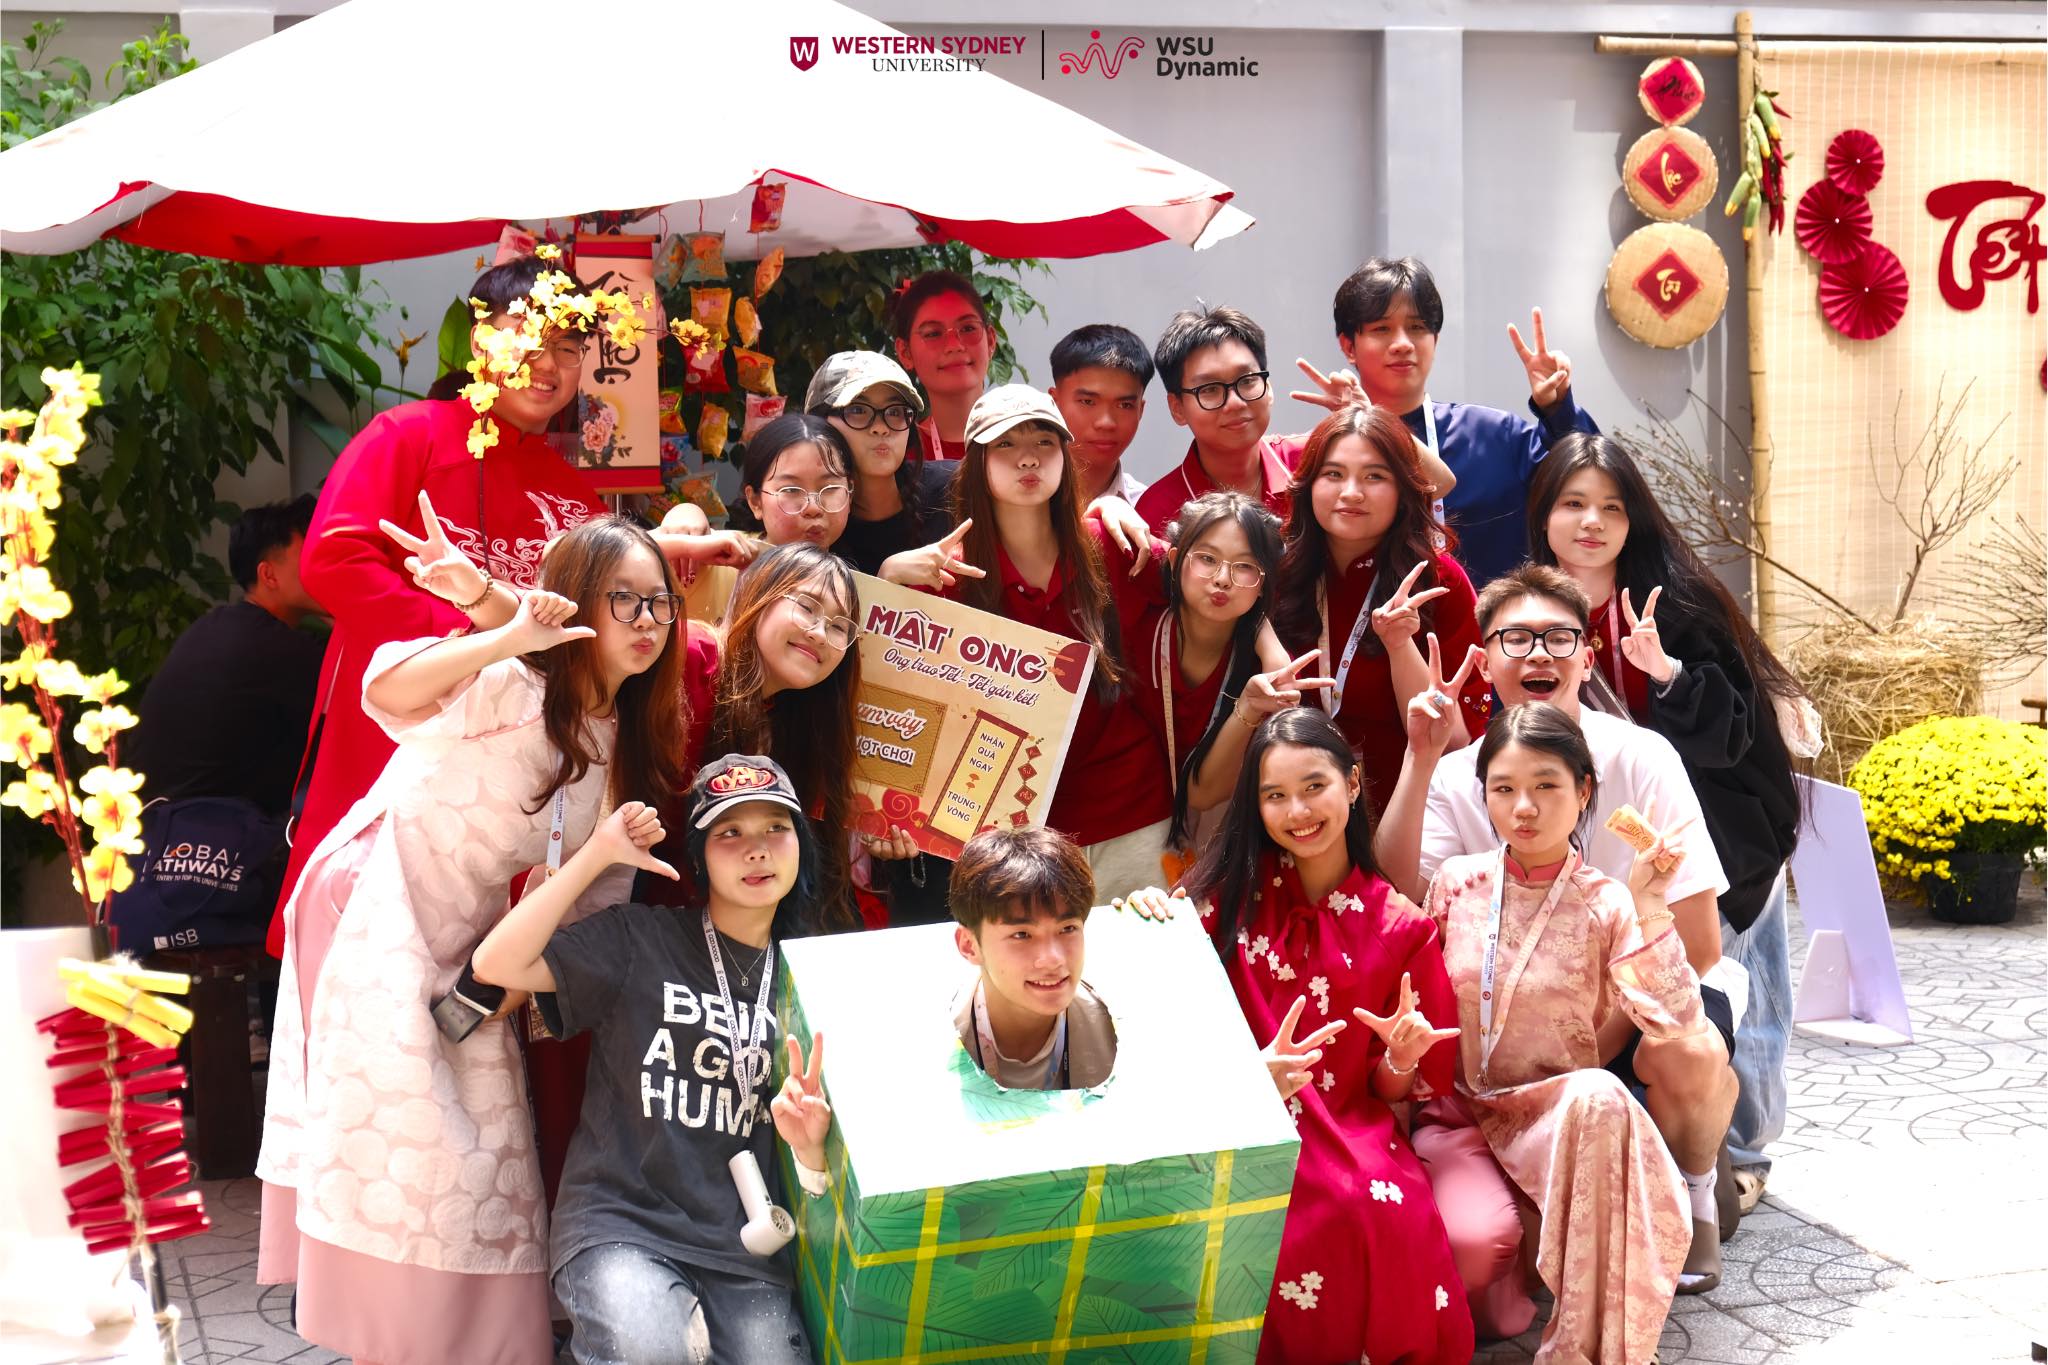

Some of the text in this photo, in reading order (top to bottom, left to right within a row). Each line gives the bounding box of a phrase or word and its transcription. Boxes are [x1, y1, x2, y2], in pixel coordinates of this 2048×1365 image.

[960, 636, 1046, 683] ONG
[884, 648, 910, 671] Ong
[911, 656, 938, 676] trao
[939, 664, 964, 684] Tết
[968, 673, 994, 692] Tết
[988, 683, 1014, 702] gắn
[1014, 688, 1041, 708] kết
[857, 702, 885, 723] um
[980, 732, 1006, 750] NHẬN
[881, 744, 915, 764] CHƠI
[969, 757, 994, 773] NGAY
[147, 843, 240, 866] LOBA
[143, 859, 243, 881] ATHWAYS
[170, 928, 198, 947] ISB
[663, 981, 776, 1041] BEIN
[642, 1027, 677, 1071] A
[692, 1037, 774, 1087] GO
